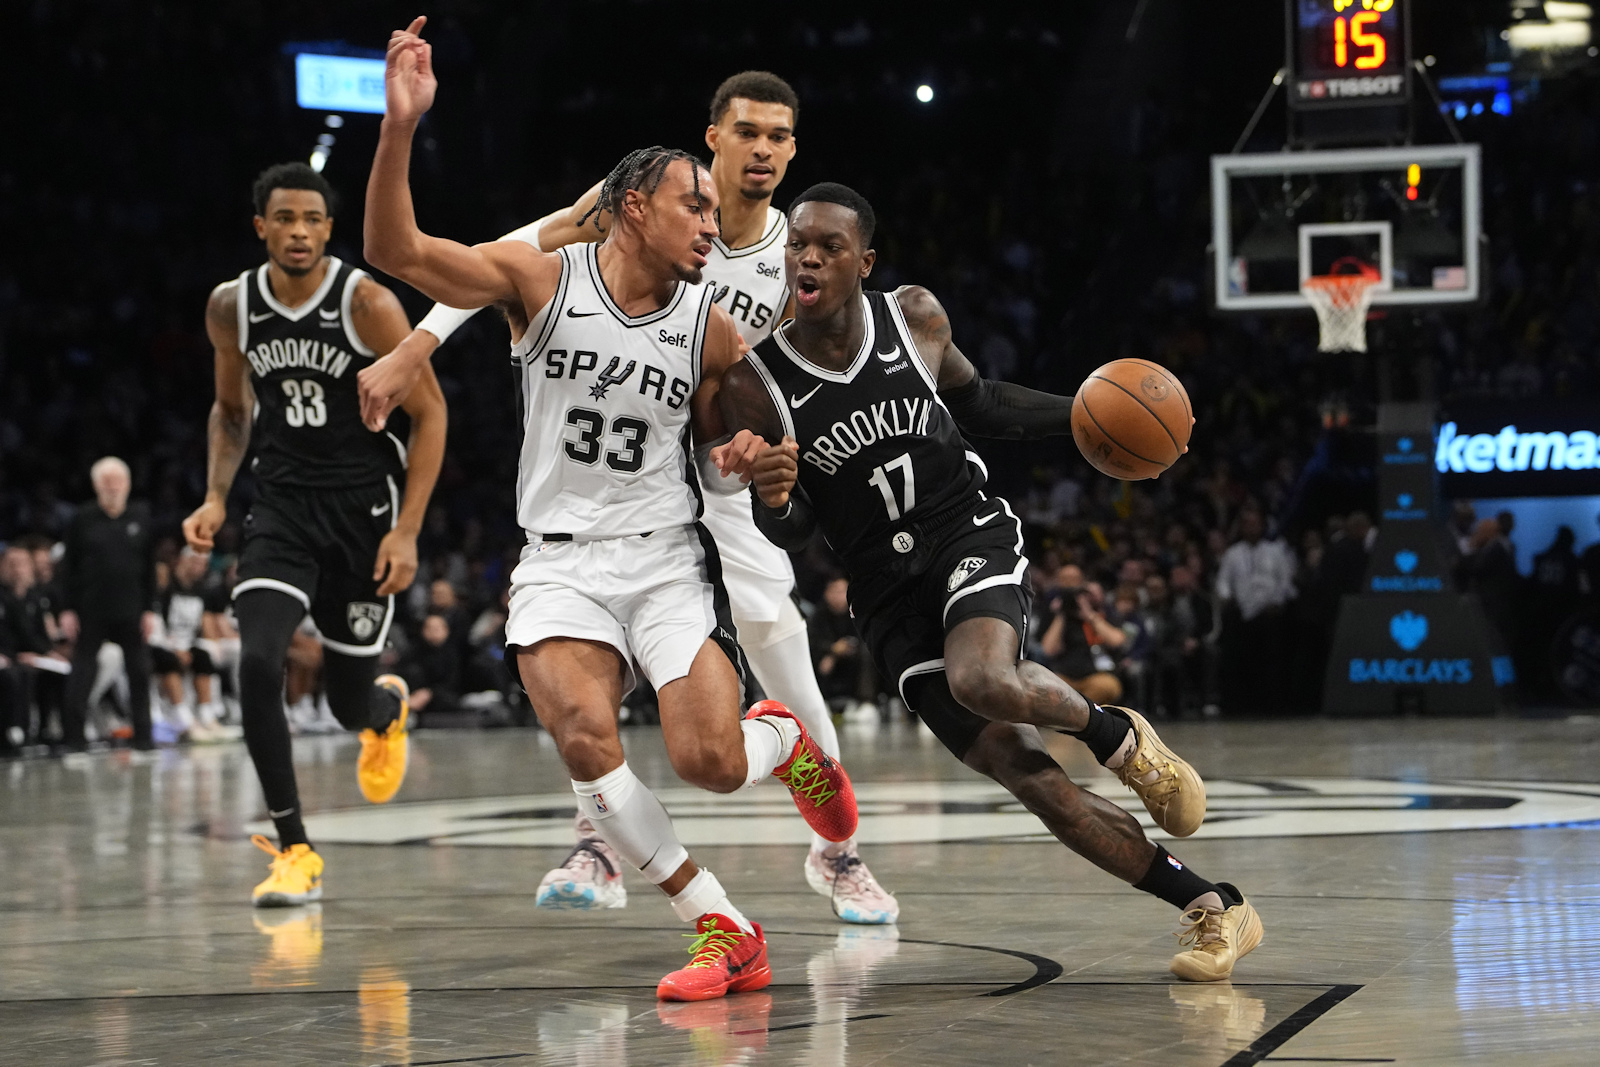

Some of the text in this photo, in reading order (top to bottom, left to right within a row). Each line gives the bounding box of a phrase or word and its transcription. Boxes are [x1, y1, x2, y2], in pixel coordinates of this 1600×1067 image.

[1334, 10, 1386, 69] 15
[756, 262, 780, 280] Self.
[247, 337, 352, 380] BROOKLYN
[658, 329, 688, 349] Self.
[545, 349, 689, 410] SPURS
[884, 361, 909, 376] Webull
[281, 379, 328, 428] 33
[563, 405, 652, 475] 33
[803, 397, 933, 476] BROOKLYN
[1434, 420, 1600, 473] ketma
[868, 452, 916, 522] 17
[1349, 658, 1472, 683] BARCLAYS
